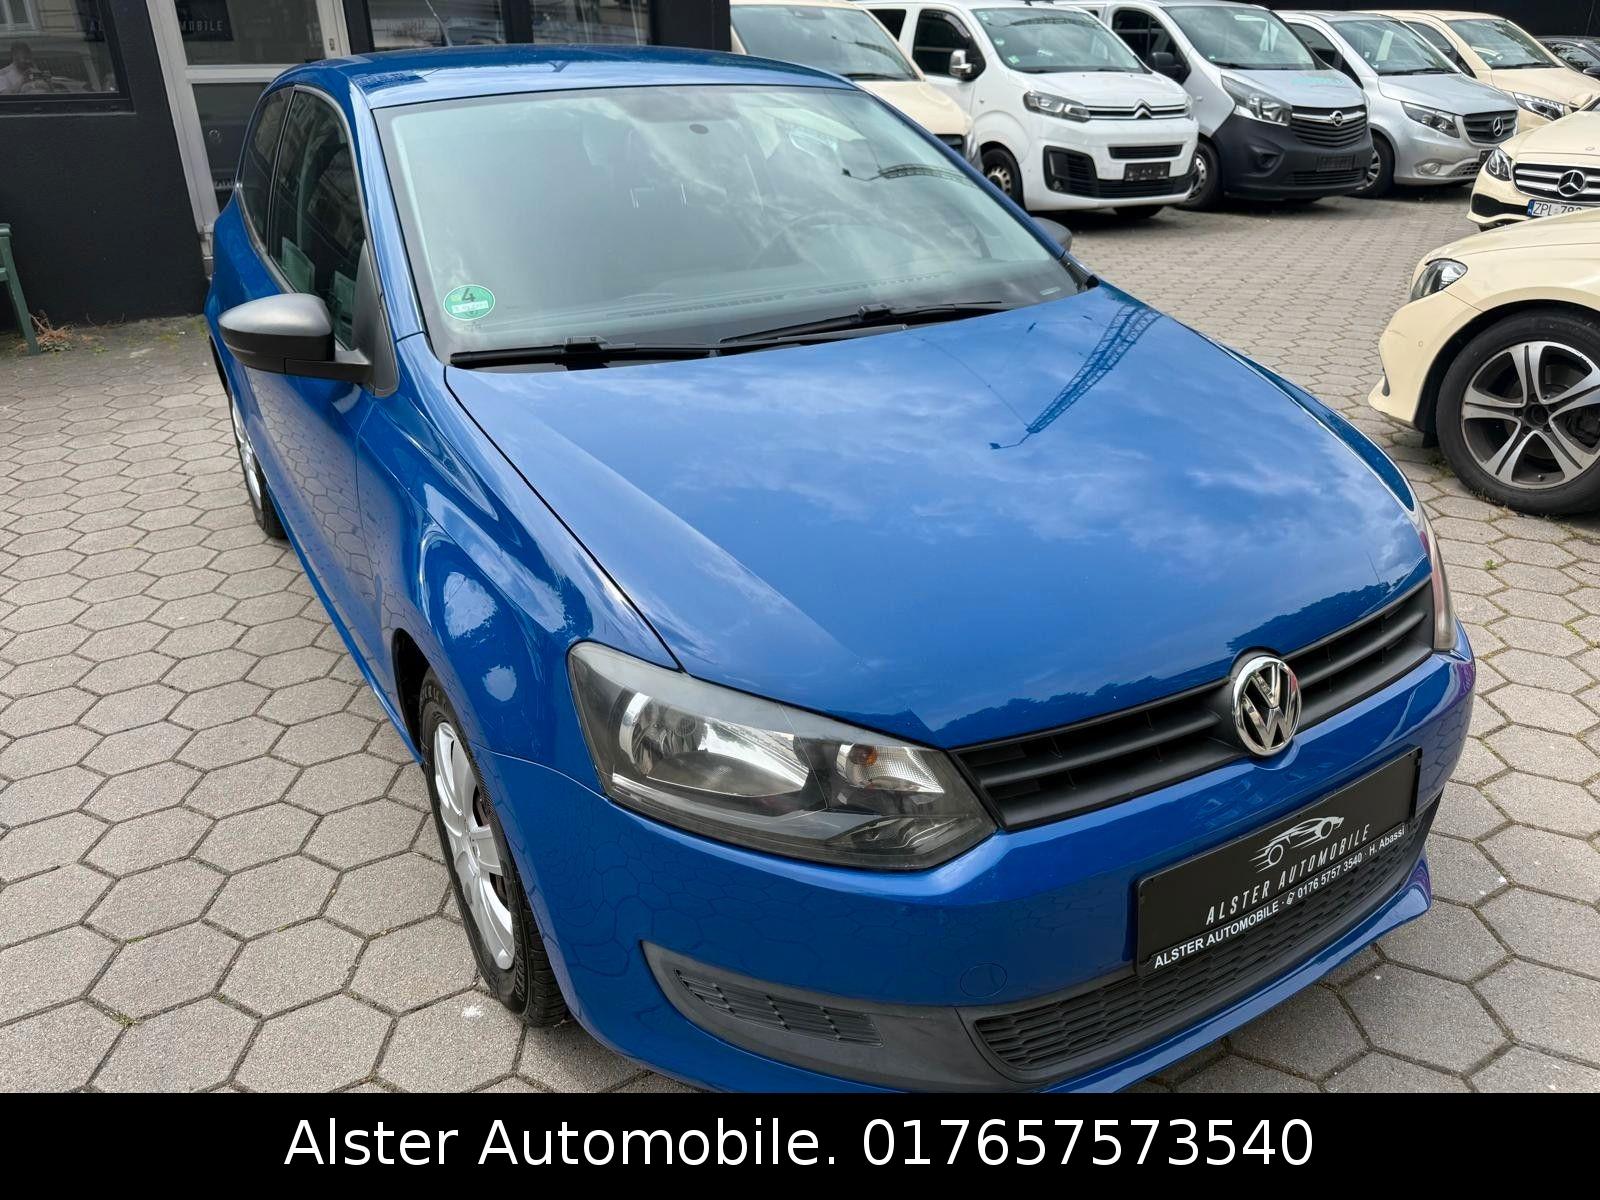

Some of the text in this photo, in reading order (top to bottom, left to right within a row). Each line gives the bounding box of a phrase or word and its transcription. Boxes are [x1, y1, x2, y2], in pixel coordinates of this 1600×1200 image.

[1154, 825, 1406, 969] ALSTER AUTOMOBILE 0176 5757 3540 H. Abassi
[1205, 823, 1371, 926] ALSTER AUTOMOBILE
